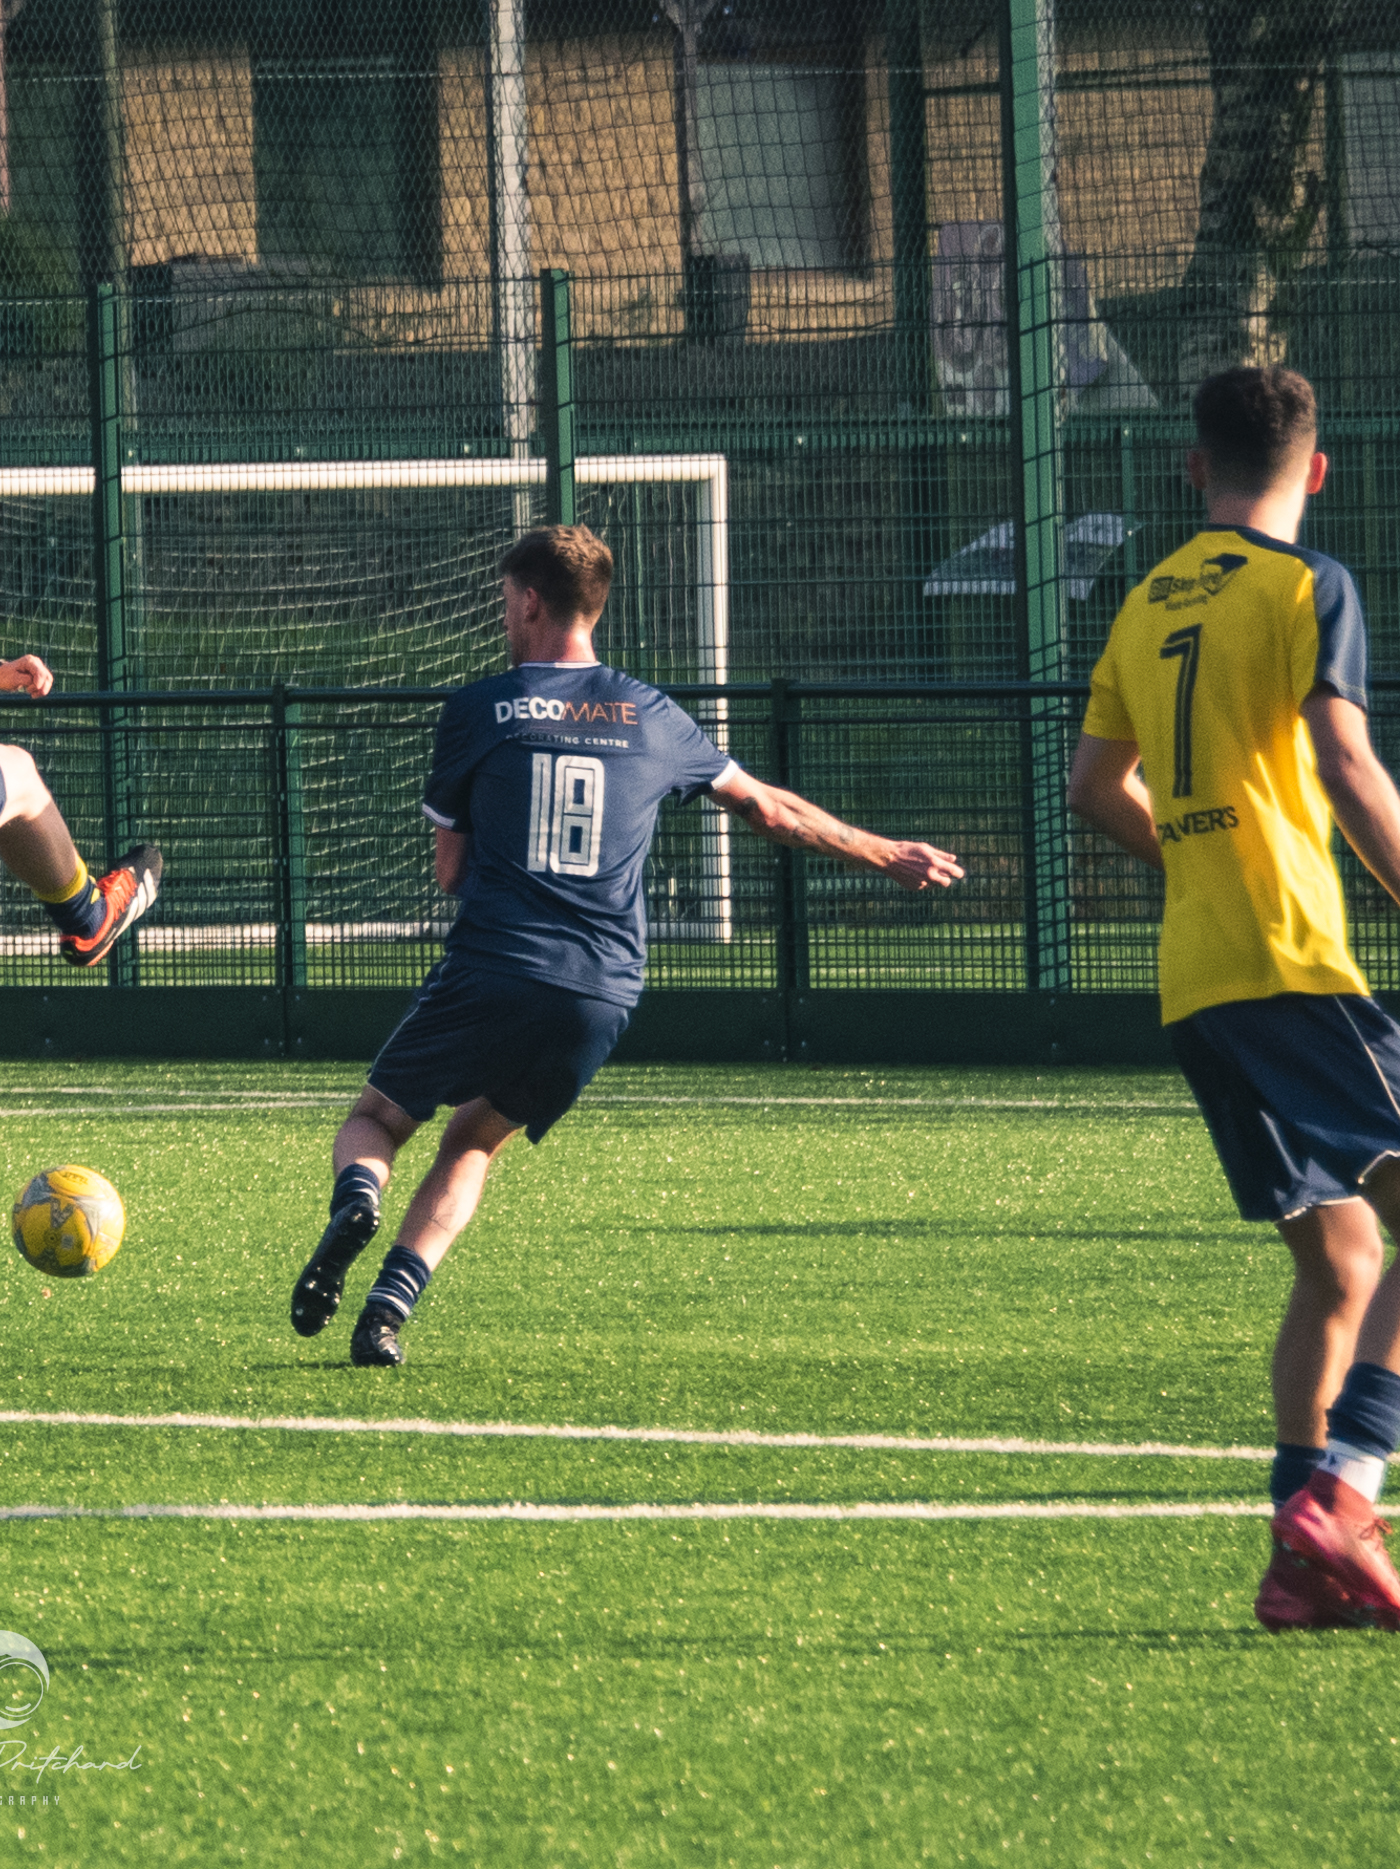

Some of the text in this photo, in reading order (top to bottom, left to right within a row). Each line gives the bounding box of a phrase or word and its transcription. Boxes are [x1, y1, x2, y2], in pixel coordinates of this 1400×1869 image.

[494, 697, 639, 726] DECOMATE
[585, 737, 629, 748] CENTRE
[1160, 623, 1202, 797] 7
[527, 753, 605, 877] 18
